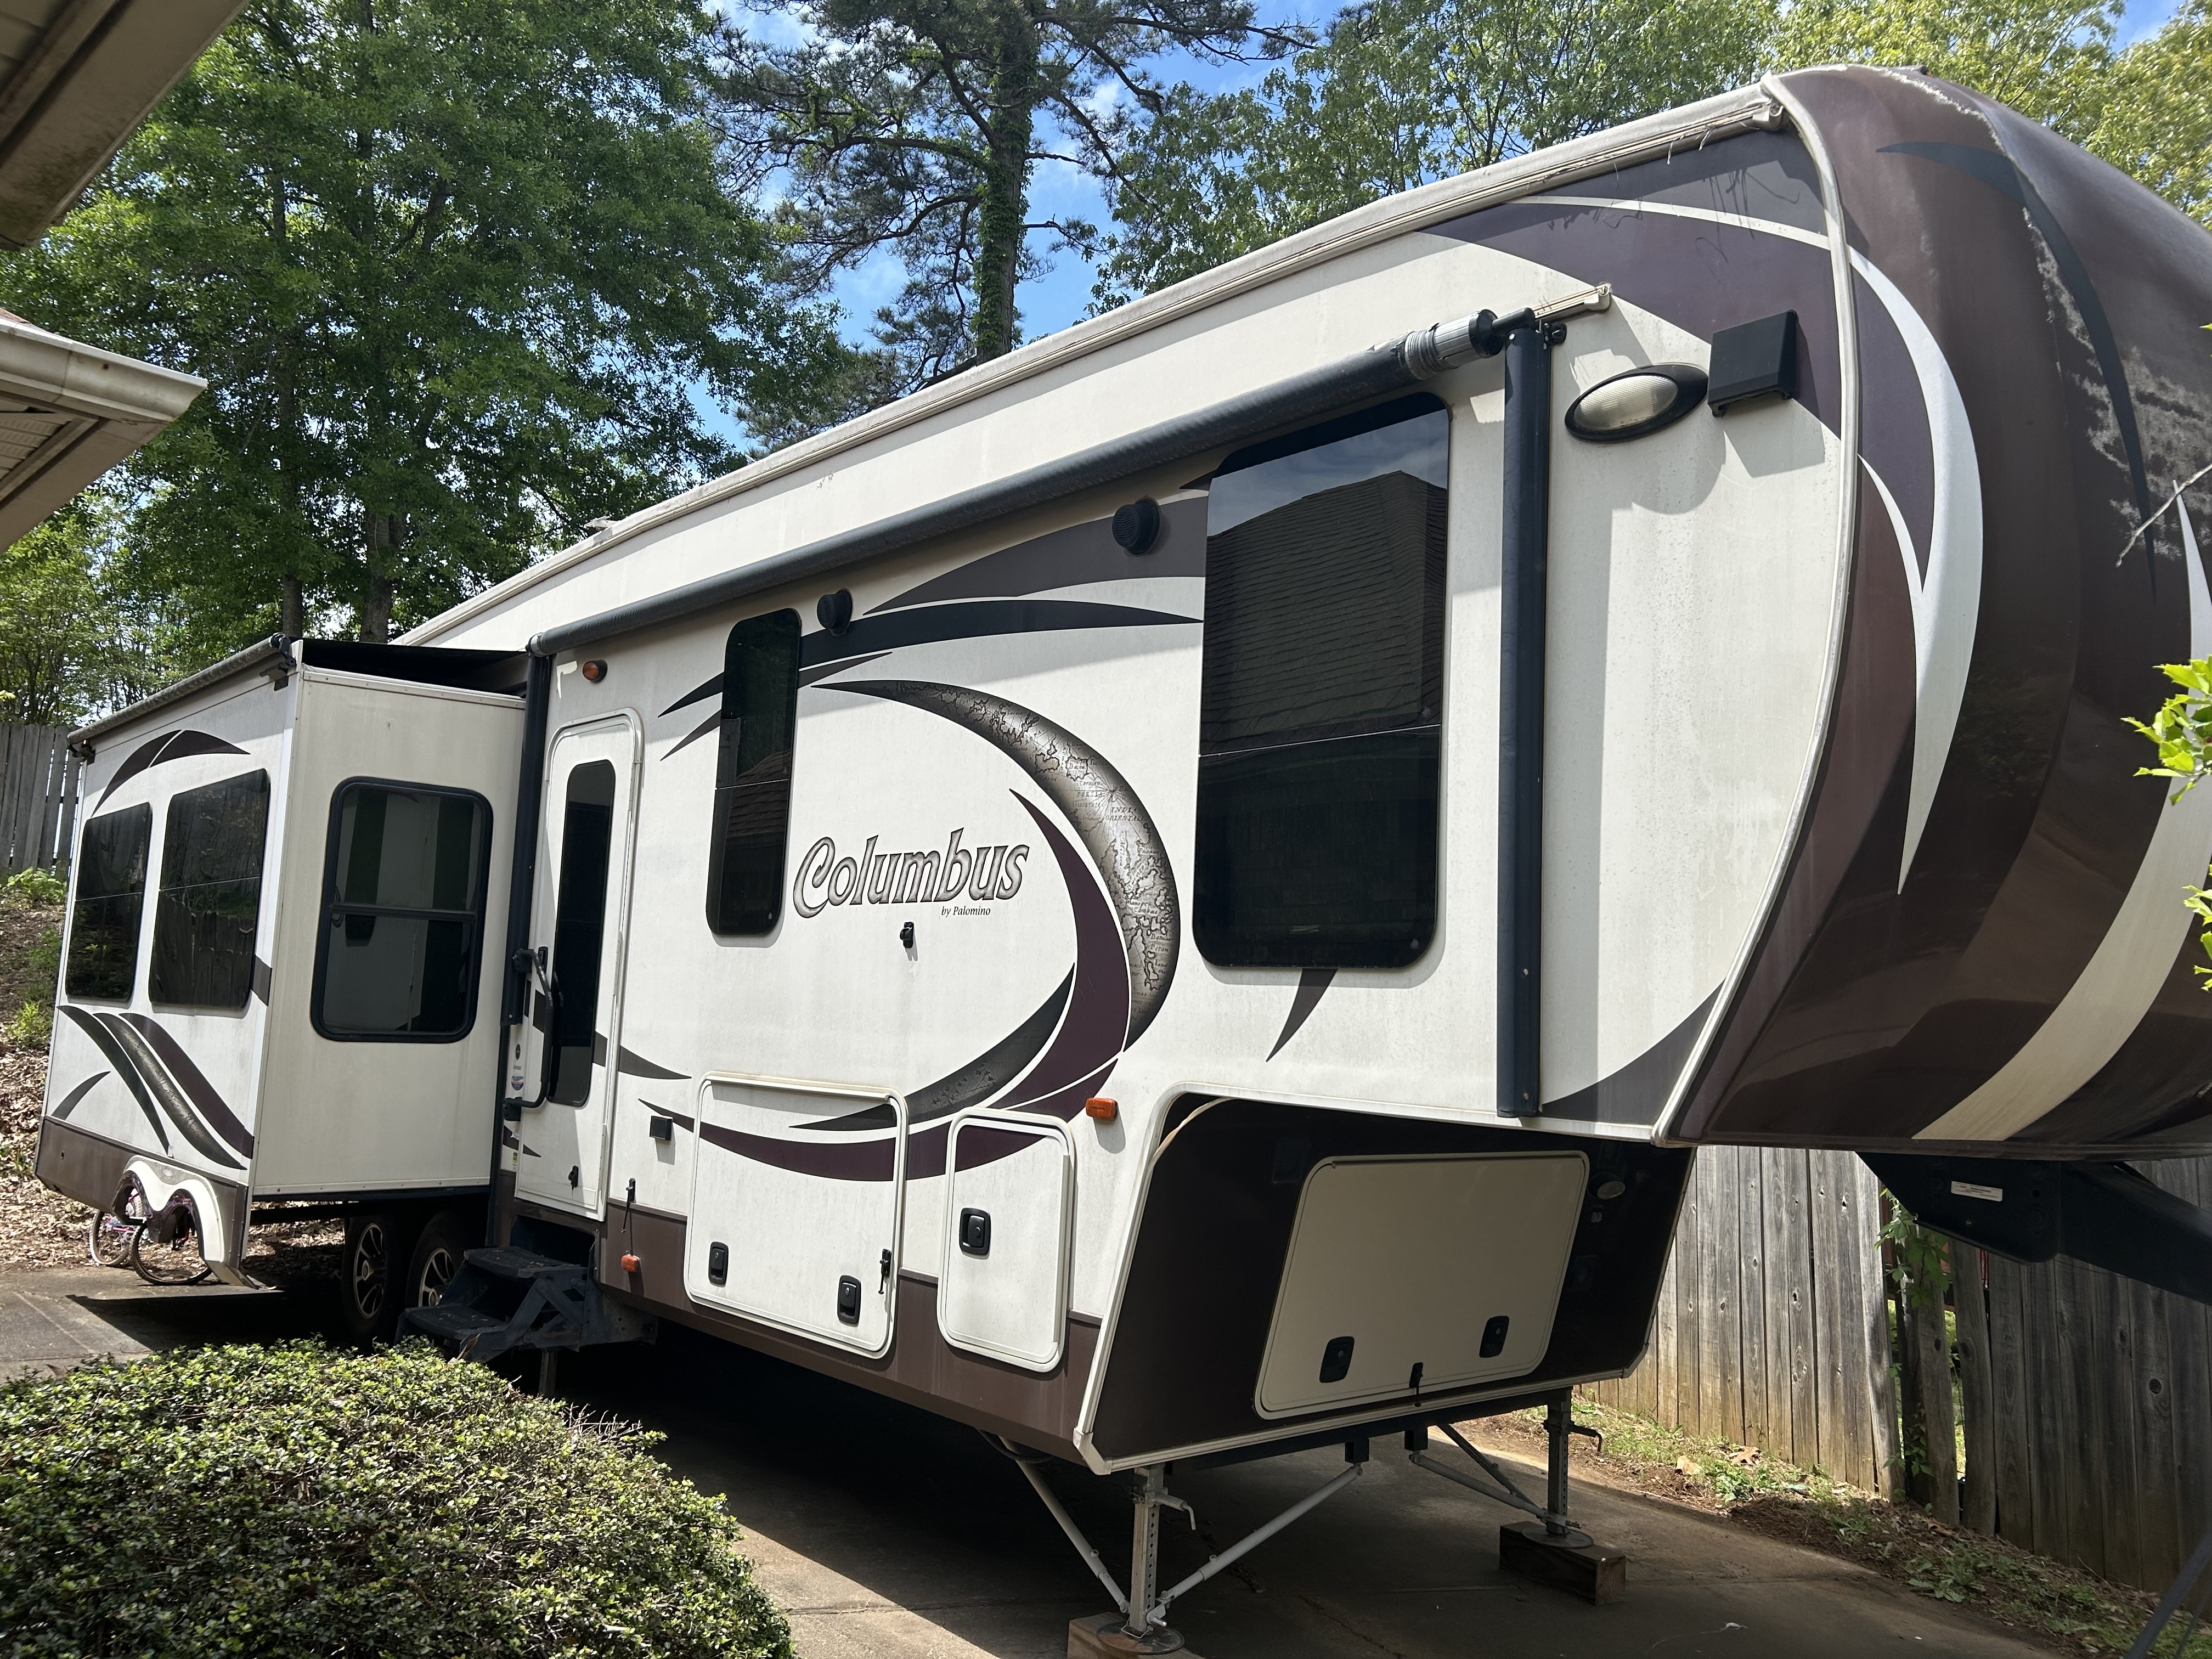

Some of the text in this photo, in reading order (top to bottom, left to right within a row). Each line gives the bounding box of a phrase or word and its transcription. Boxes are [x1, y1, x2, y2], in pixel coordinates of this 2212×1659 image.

[793, 827, 1030, 918] Columbus
[941, 906, 991, 917] by Palomino
